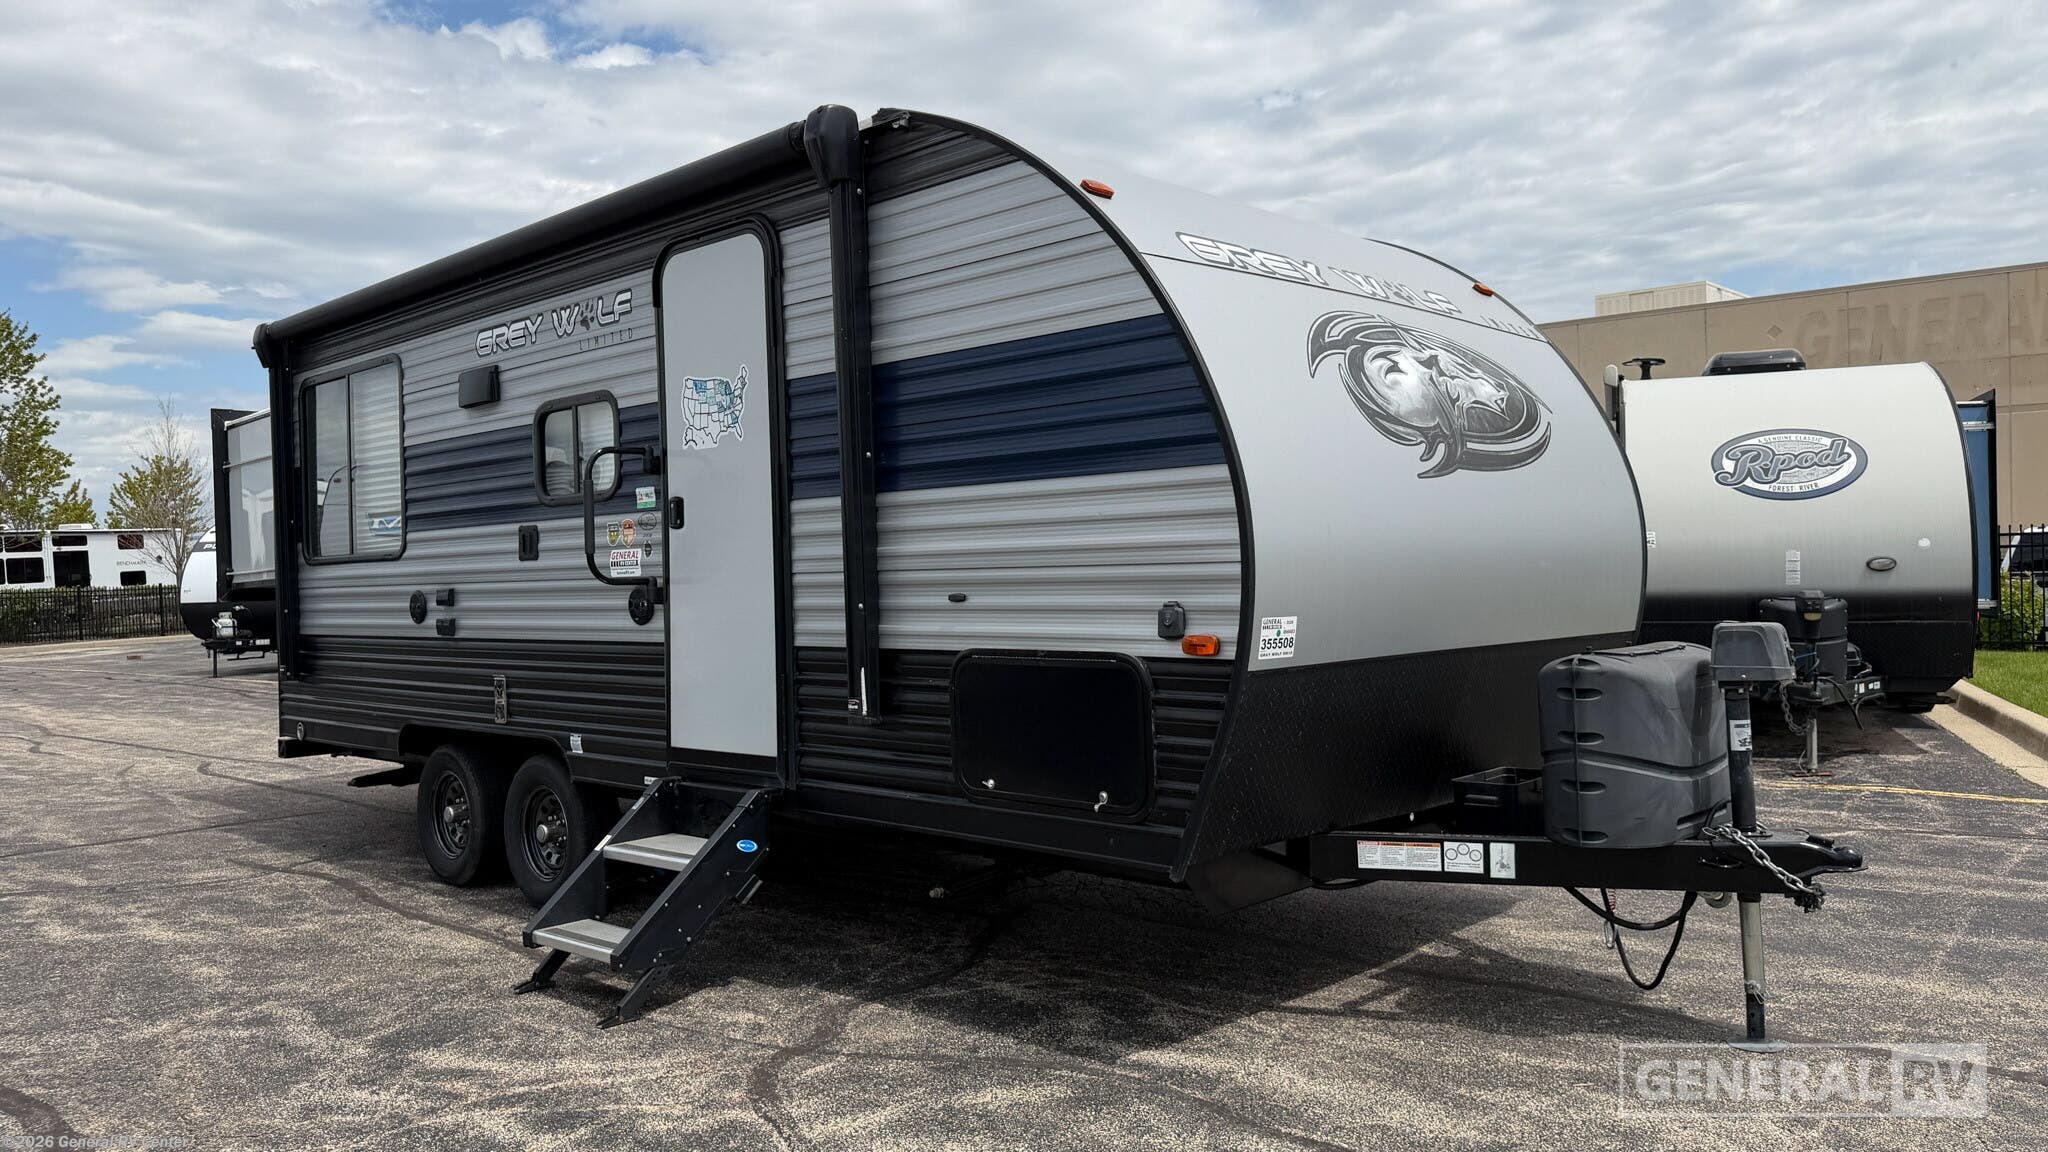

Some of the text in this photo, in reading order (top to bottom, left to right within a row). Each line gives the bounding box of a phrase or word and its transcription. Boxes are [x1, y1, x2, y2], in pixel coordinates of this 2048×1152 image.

[1175, 232, 1329, 286] GREY
[476, 313, 544, 357] GREY
[1796, 288, 2048, 366] GENERA
[579, 328, 633, 350] LIMITED
[1768, 482, 1819, 492] FOREST RIVER
[611, 550, 638, 560] GENERAL
[1261, 637, 1294, 650] 355508
